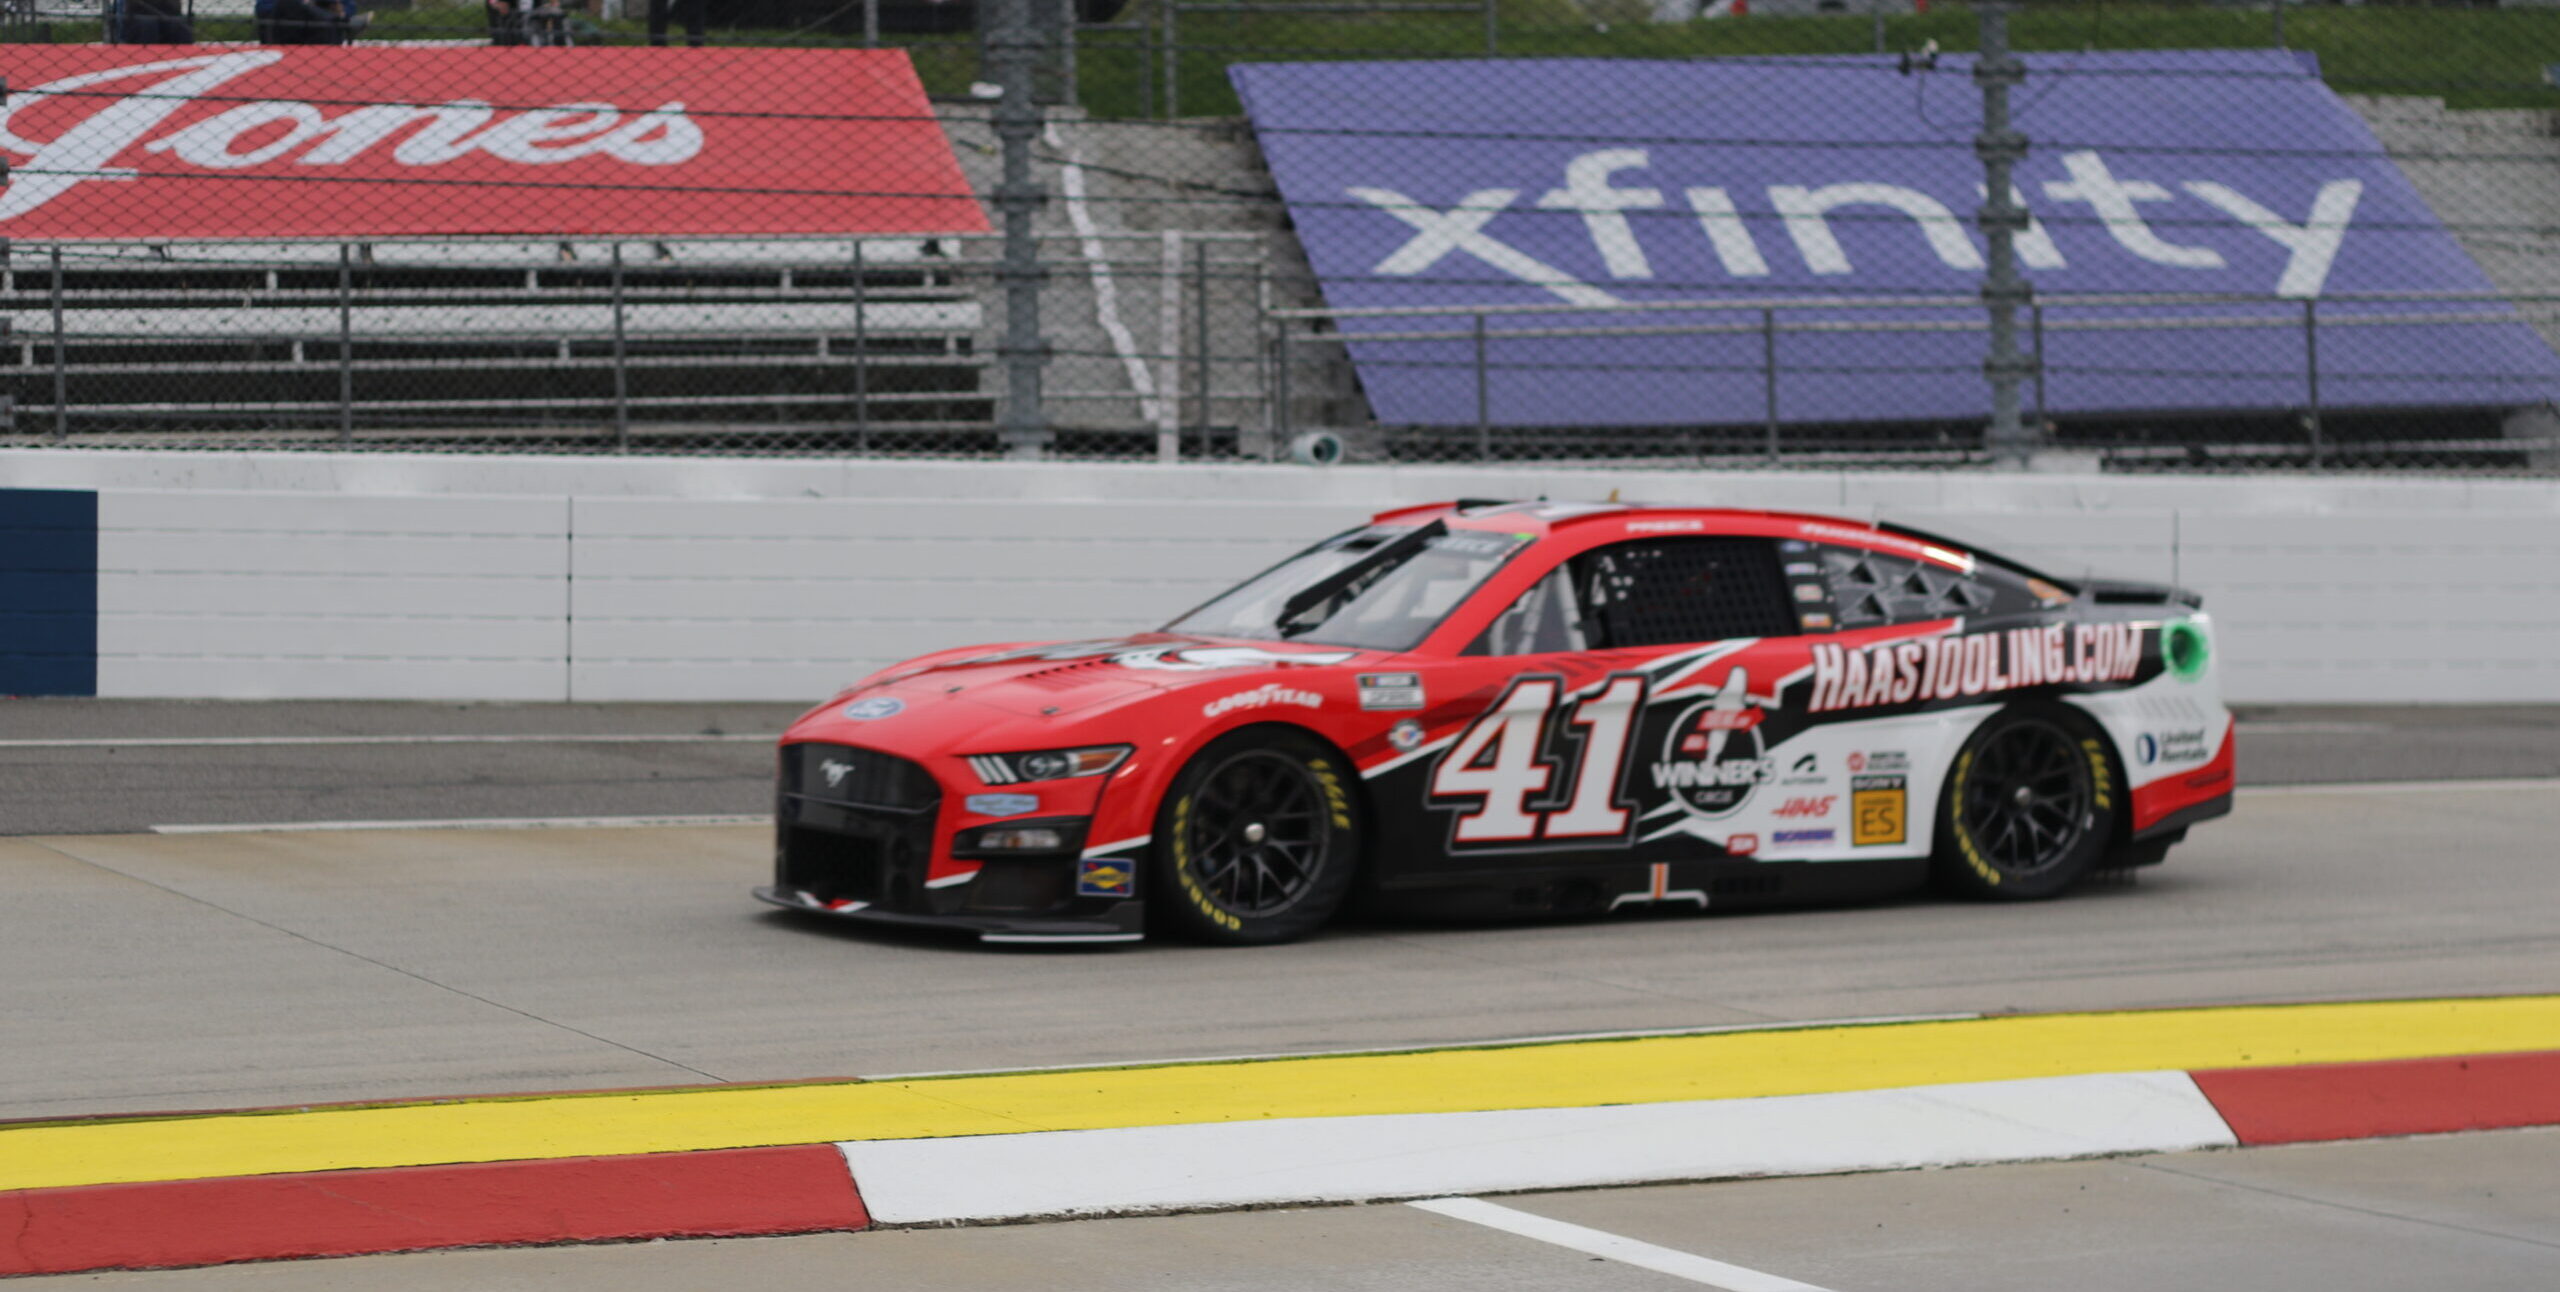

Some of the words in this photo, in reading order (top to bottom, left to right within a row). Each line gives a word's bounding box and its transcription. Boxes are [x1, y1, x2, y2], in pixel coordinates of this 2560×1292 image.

[0, 50, 704, 222] Jones
[1344, 148, 2363, 306] xfinity
[1203, 683, 1323, 718] GOODYEAR
[1807, 620, 2143, 713] HAASTOOLING.COM
[1427, 673, 1647, 848] 41
[1651, 758, 1777, 788] WINNER'S
